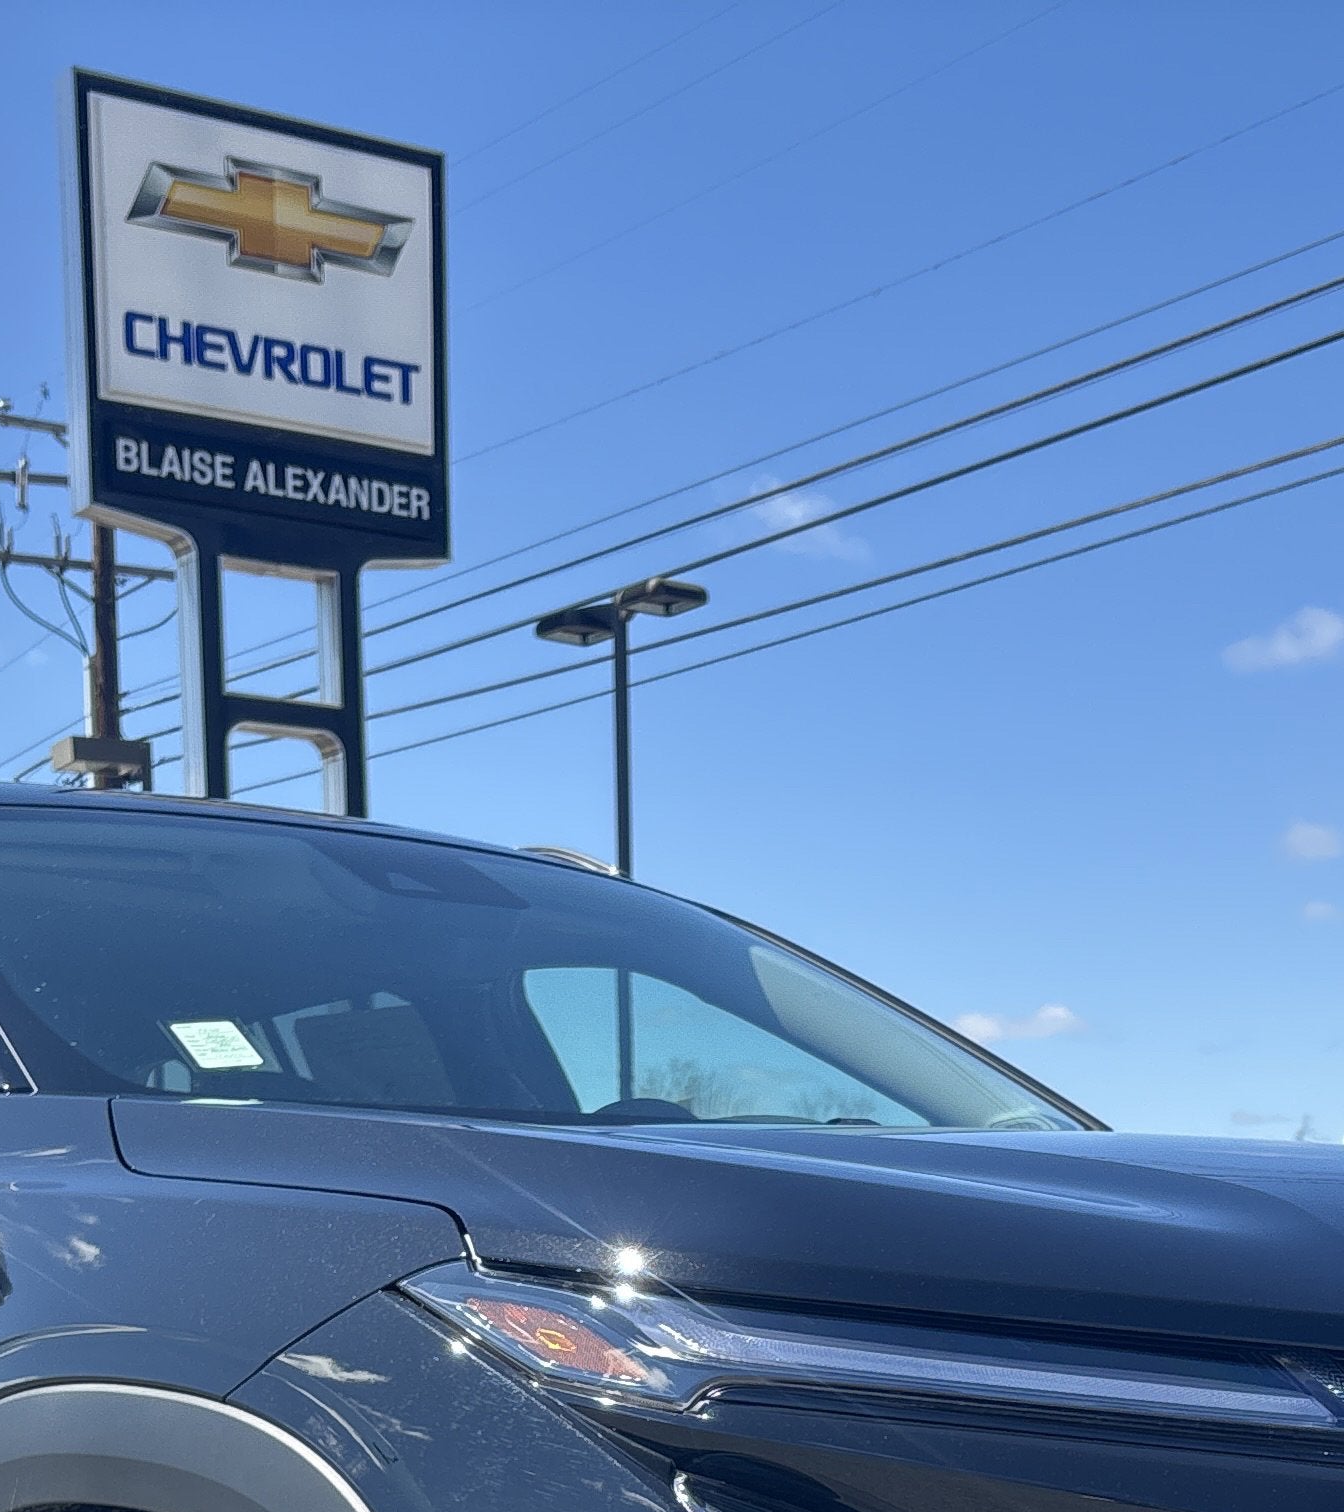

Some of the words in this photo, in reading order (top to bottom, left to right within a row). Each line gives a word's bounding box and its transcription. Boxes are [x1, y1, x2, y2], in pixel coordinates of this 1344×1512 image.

[124, 310, 420, 405] CHEVROLET
[114, 436, 236, 490] BLAISE
[243, 458, 432, 521] ALEXANDER
